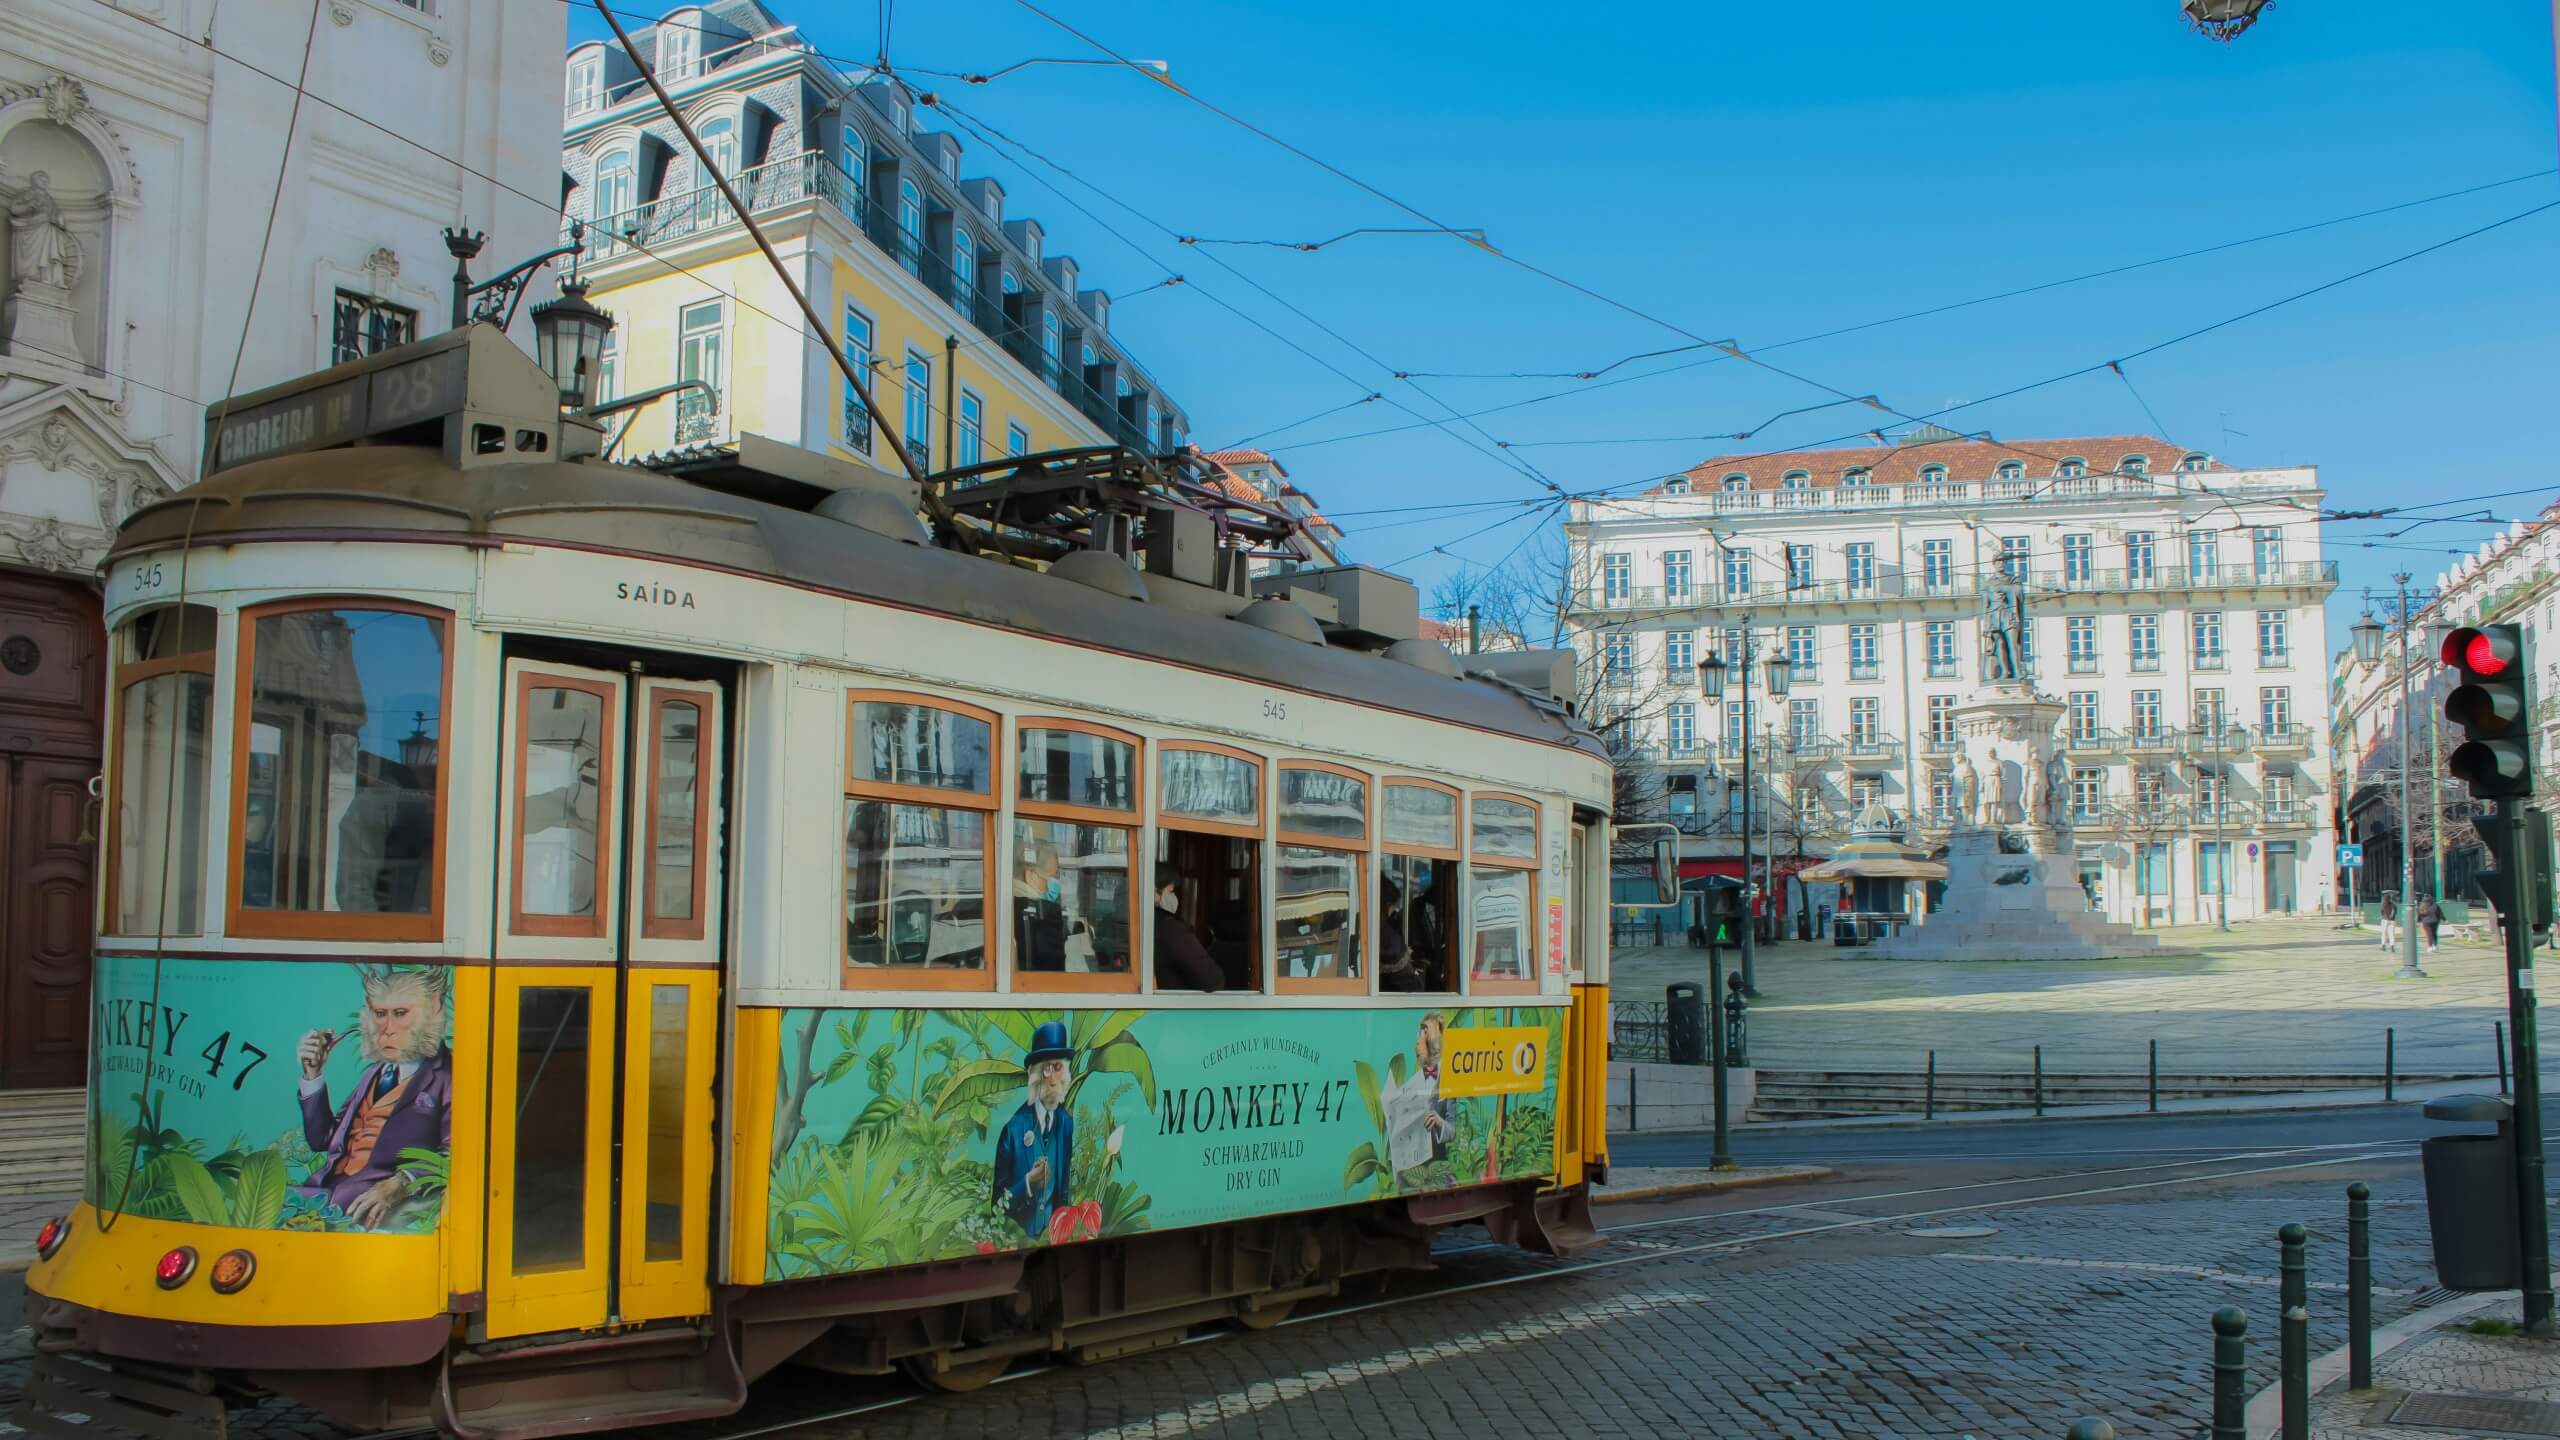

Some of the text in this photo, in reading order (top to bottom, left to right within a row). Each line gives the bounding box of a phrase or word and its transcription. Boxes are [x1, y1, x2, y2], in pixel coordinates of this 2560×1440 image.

[220, 405, 314, 462] CARREIRA
[385, 360, 434, 417] 28
[134, 563, 162, 591] 545
[617, 580, 696, 610] SAÍDA
[1262, 699, 1287, 721] 545
[201, 1030, 269, 1092] 47
[1202, 1035, 1321, 1071] CERTAINLY WUNDERBAR
[1451, 1040, 1504, 1074] carris
[178, 1074, 206, 1101] GIN
[1158, 1079, 1350, 1136] MONKEY 47
[1202, 1139, 1304, 1167] SCHWARZWALD
[1226, 1167, 1282, 1192] DRY GIN
